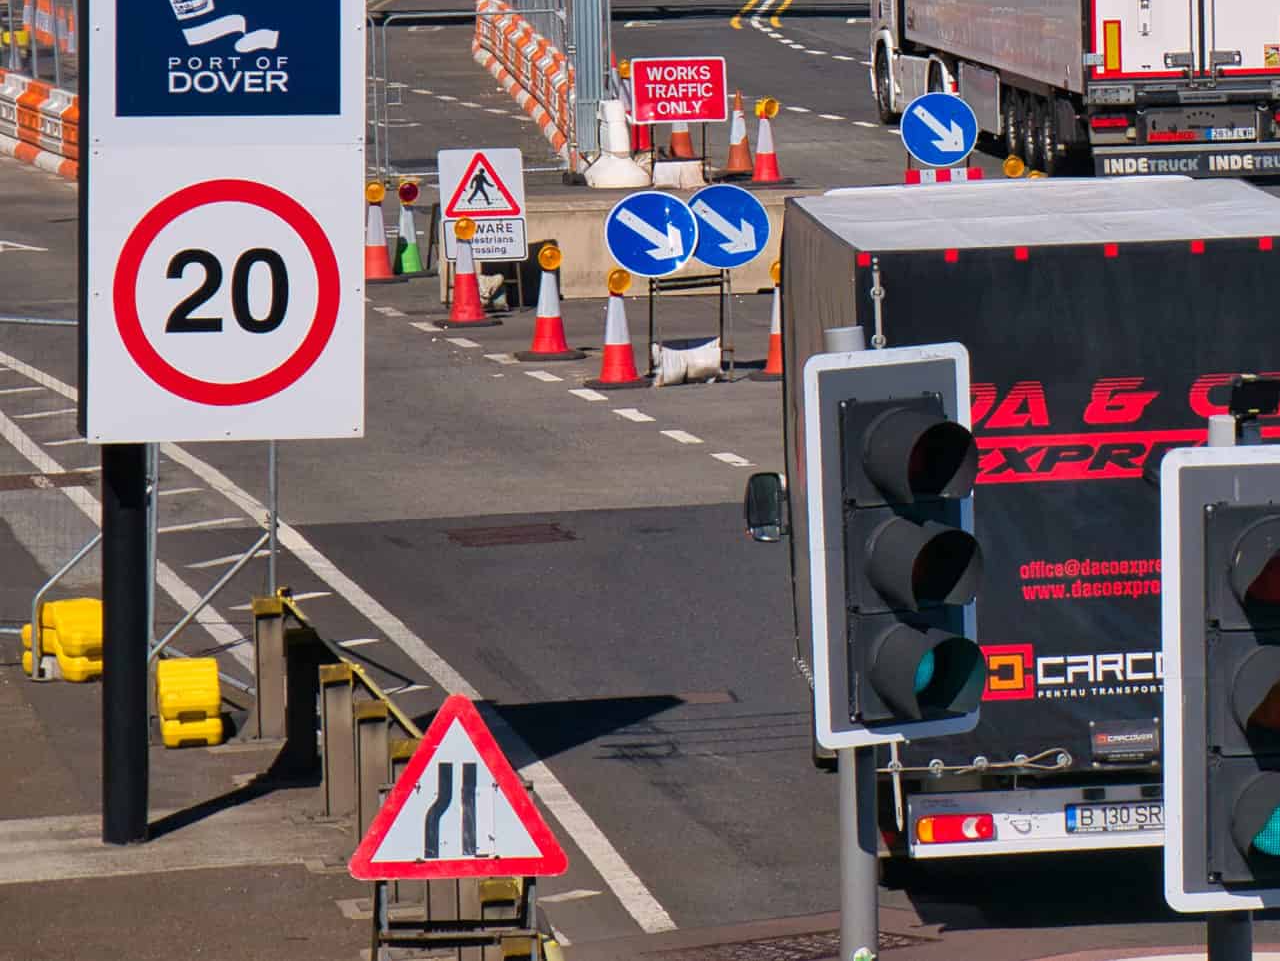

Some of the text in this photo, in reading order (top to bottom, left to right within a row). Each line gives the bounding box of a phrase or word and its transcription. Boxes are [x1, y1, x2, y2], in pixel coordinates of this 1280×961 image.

[168, 57, 288, 70] PORT OF
[646, 65, 711, 81] WORKS
[168, 71, 288, 93] DOVER
[645, 83, 713, 98] TRAFFIC
[657, 100, 702, 115] ONLY
[475, 223, 513, 234] WARE
[472, 246, 507, 254] rossing
[165, 246, 290, 335] 20
[1083, 376, 1160, 425] &
[1020, 559, 1162, 579] office@dacoexpre
[1022, 579, 1161, 600] www.dacoexpre
[1038, 688, 1086, 699] PENTRU
[1081, 807, 1094, 827] B
[1102, 806, 1130, 826] 130
